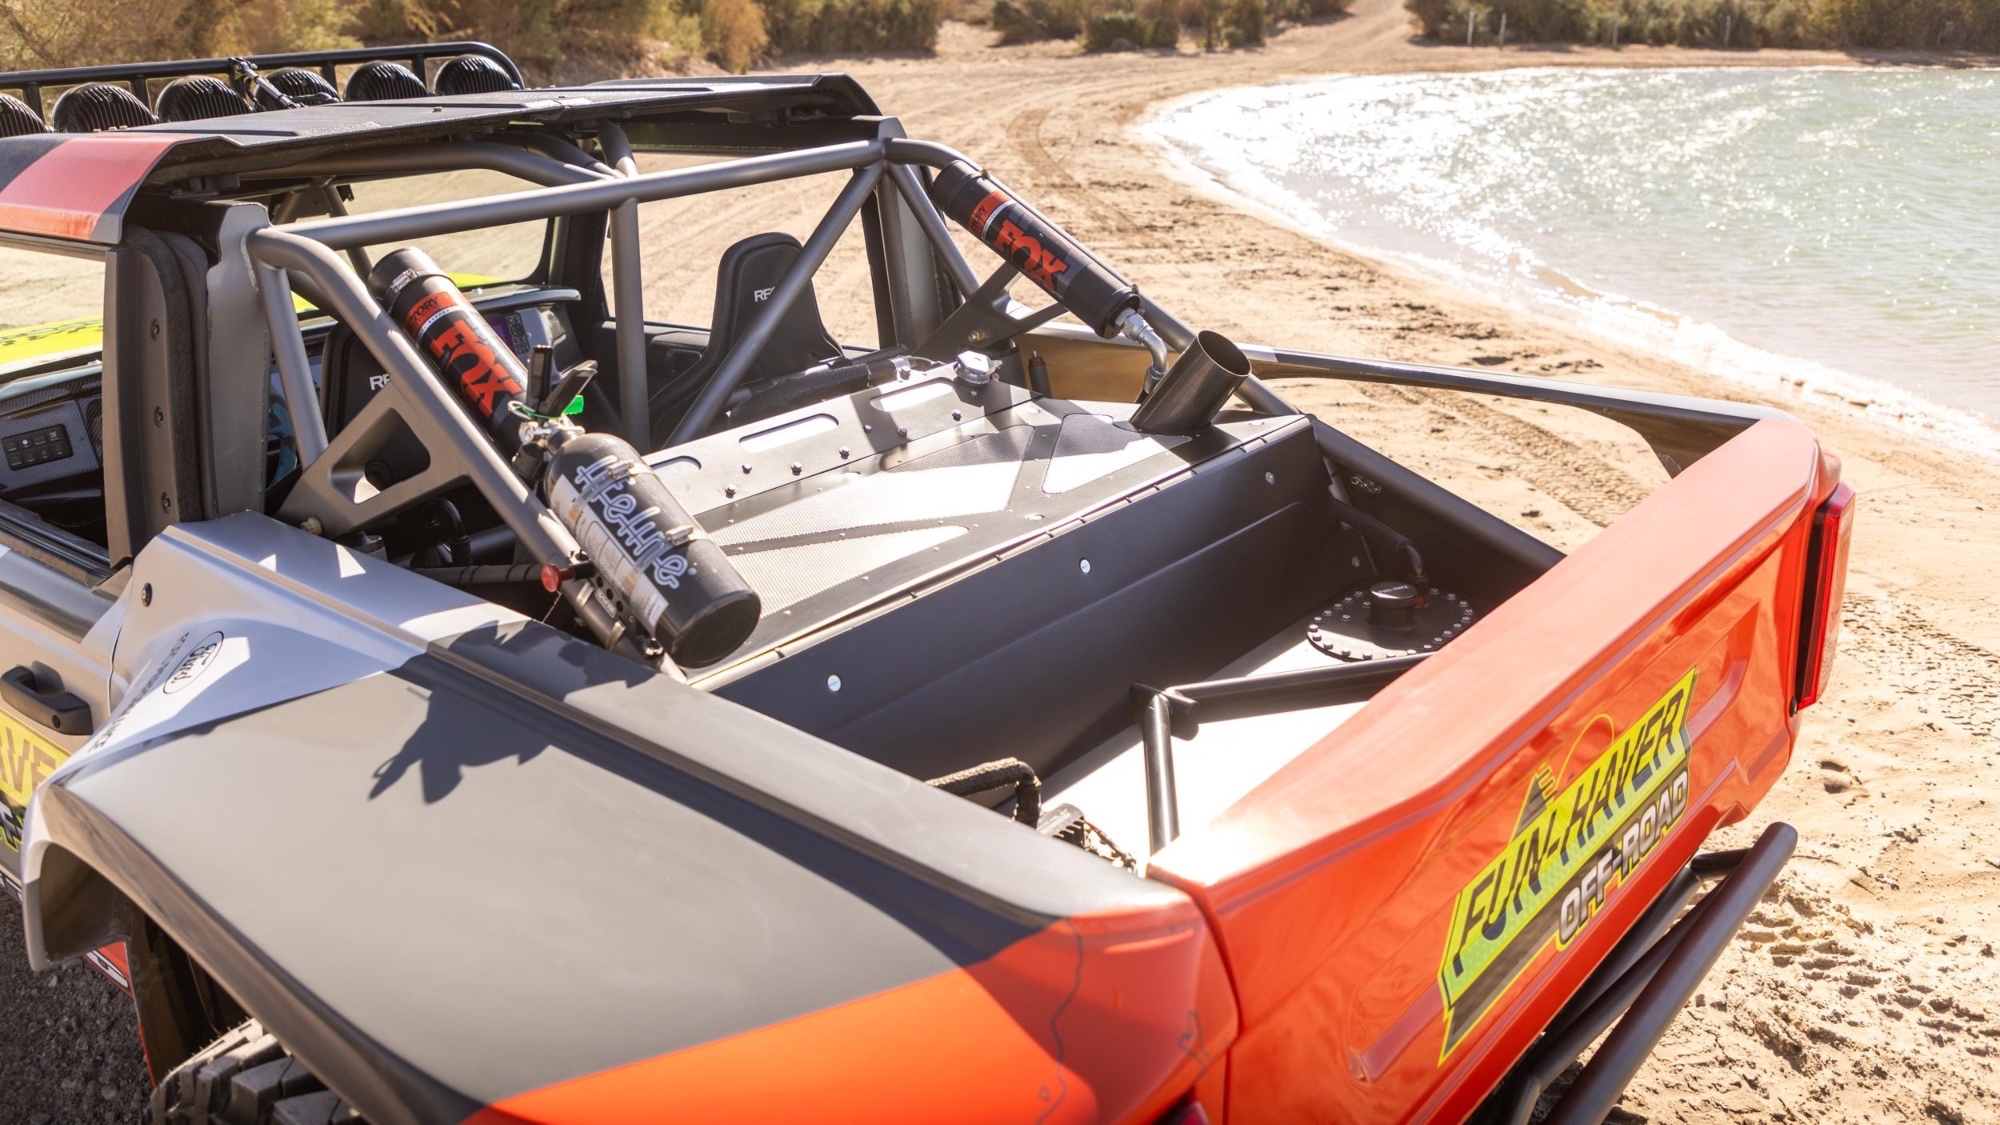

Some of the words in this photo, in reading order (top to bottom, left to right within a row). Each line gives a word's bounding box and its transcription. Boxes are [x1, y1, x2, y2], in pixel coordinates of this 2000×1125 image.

[994, 218, 1069, 293] FOX
[429, 318, 523, 419] FOX
[1452, 688, 1685, 978] FUN-HAVER
[1558, 770, 1690, 945] OFF-ROAD
